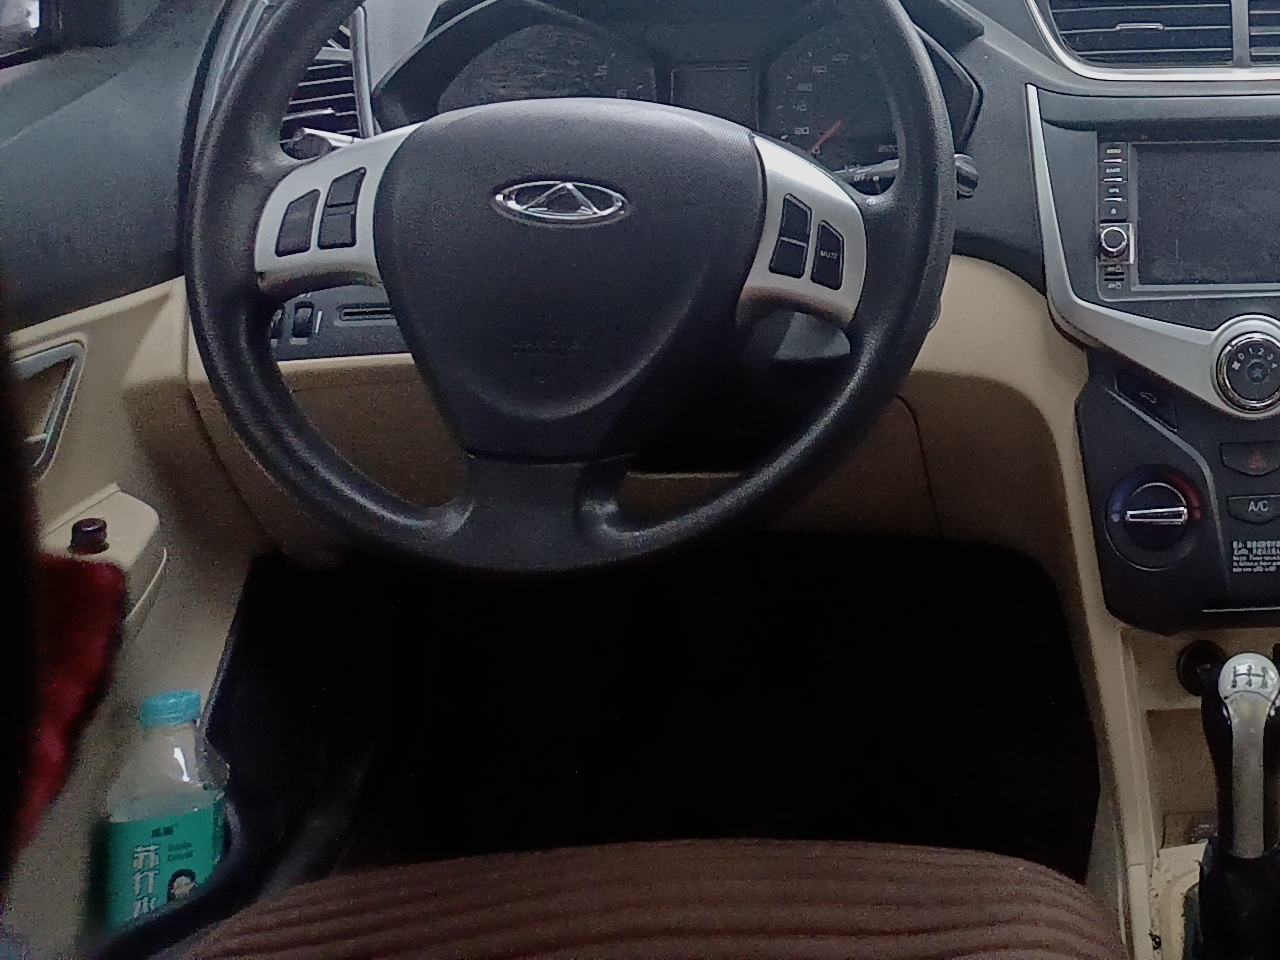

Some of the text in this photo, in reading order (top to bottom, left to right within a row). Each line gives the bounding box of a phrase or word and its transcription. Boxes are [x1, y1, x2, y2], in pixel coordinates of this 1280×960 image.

[853, 173, 866, 181] OFF
[819, 250, 838, 259] MUTE
[1237, 352, 1245, 361] 0
[1248, 347, 1253, 355] 1
[1257, 347, 1265, 357] 2
[1247, 499, 1269, 513] A/C
